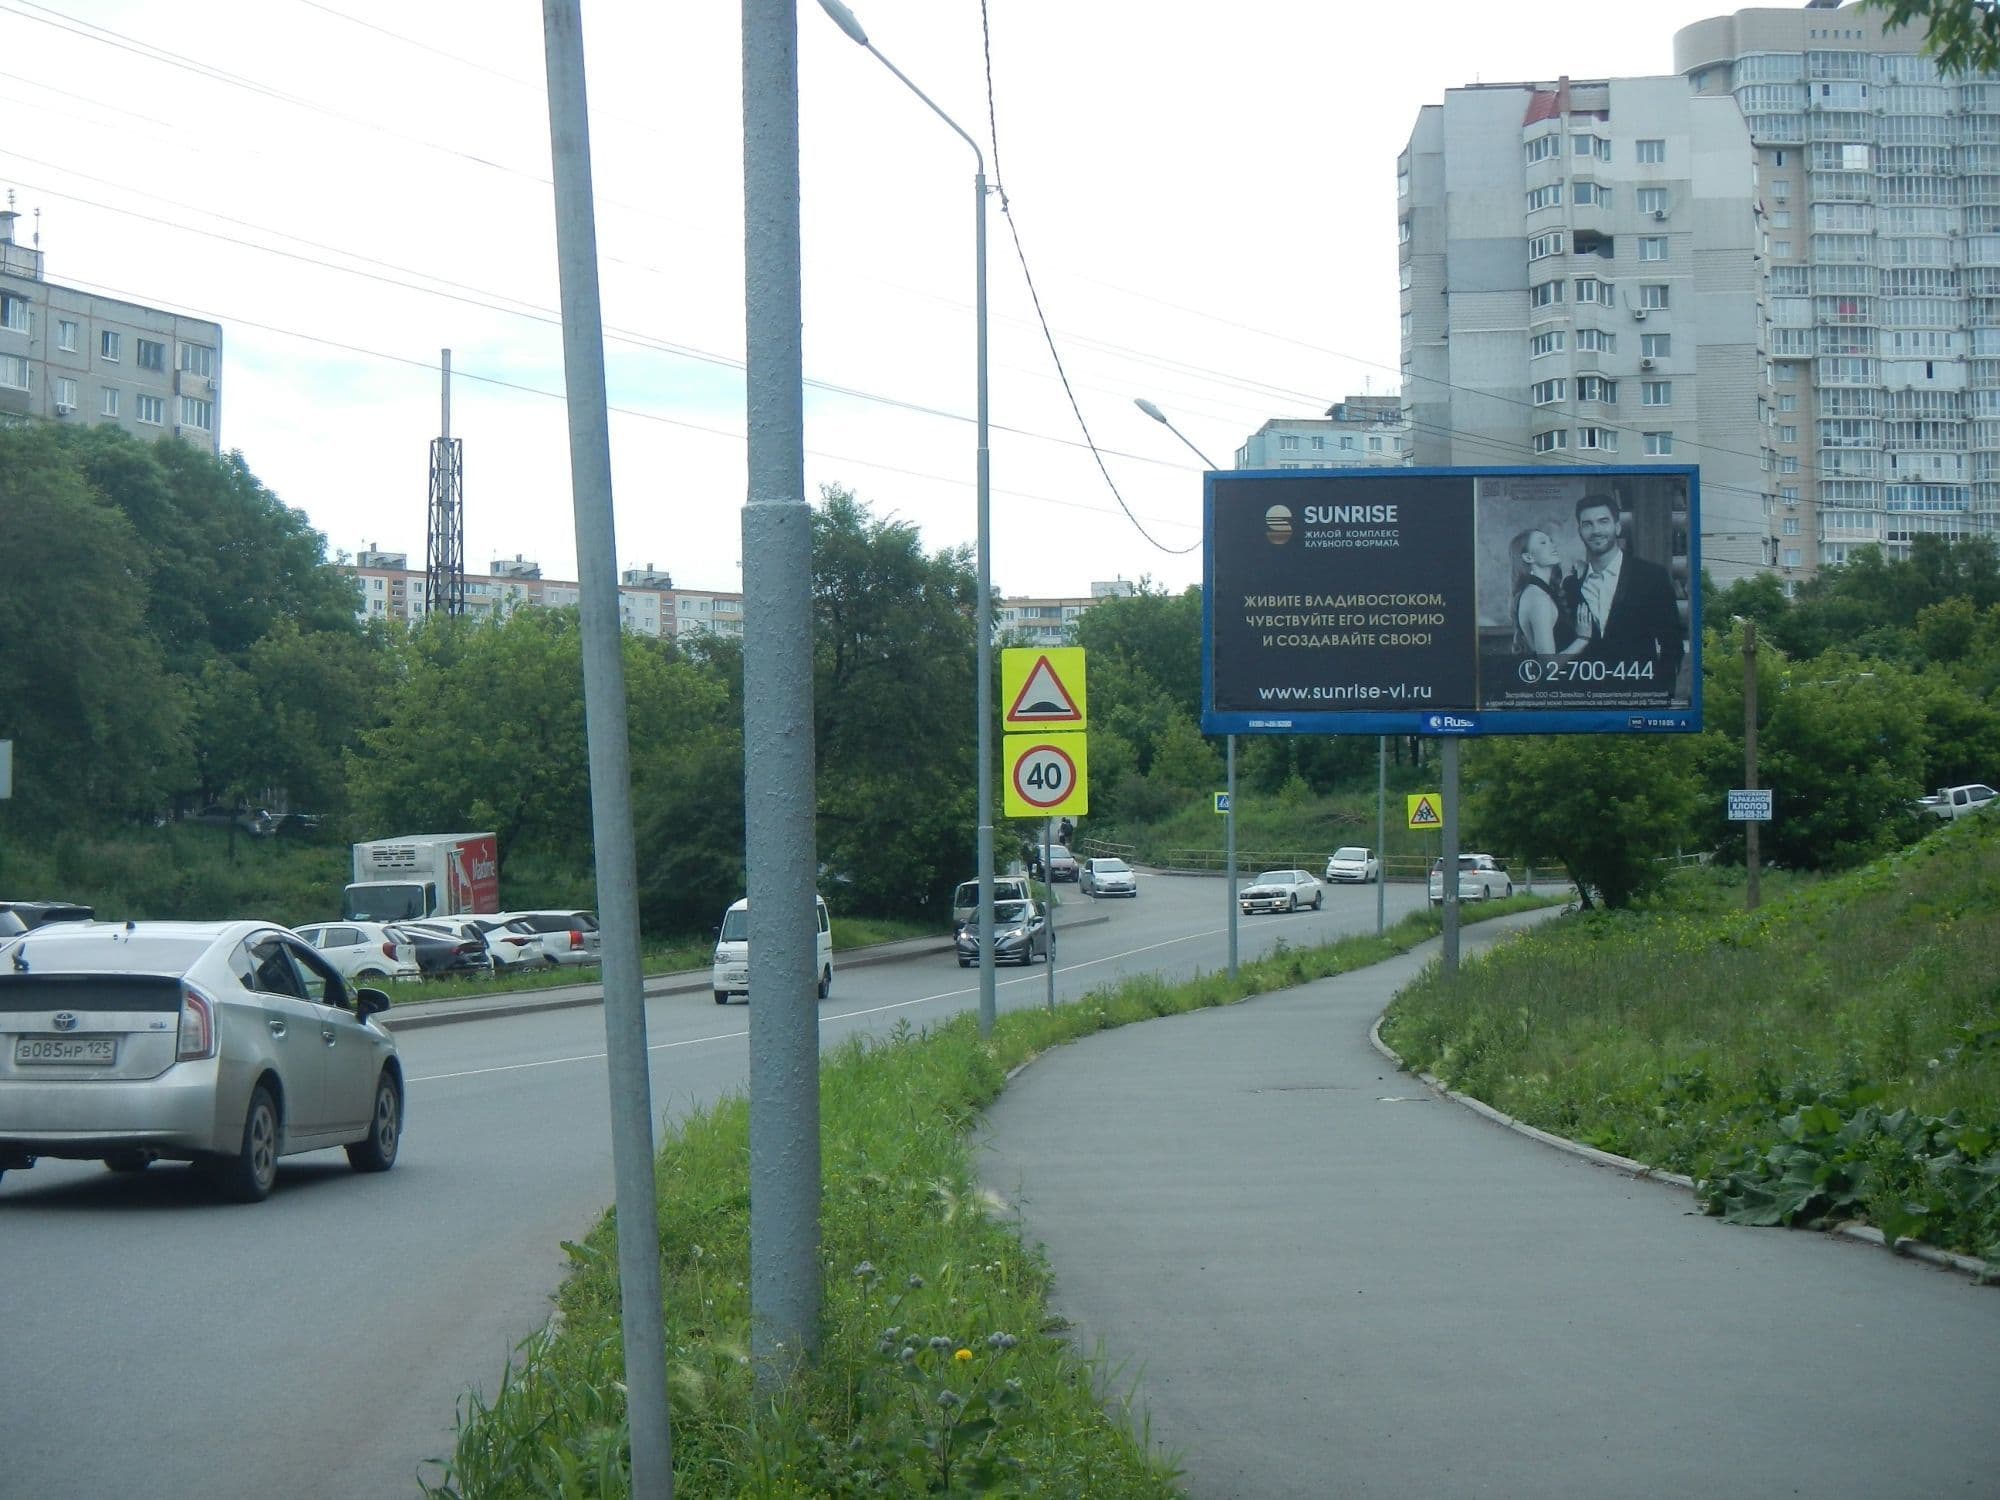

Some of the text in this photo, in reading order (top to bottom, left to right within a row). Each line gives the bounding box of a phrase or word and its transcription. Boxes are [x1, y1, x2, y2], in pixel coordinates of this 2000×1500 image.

[1304, 505, 1398, 524] SUNRISE
[1304, 529, 1400, 538] ЖИЛОЙ КОМПЛЕКС
[1304, 539, 1400, 548] КЛУБНОГО ФОРМАТА
[1244, 593, 1447, 608] ЖИВИТЕ ВЛАДИВОСТОКОМ,
[1246, 613, 1445, 627] ЧУВСТВУЙТЕ ЕГО ИСТОРИЮ
[1262, 632, 1432, 647] И СОЗДАВАЙТЕ СВОЮ!
[1545, 660, 1655, 681] 2-700-444
[1258, 683, 1433, 699] www.sunrise-vl.ru
[1027, 762, 1062, 790] 40
[1732, 802, 1768, 810] КЛОПОВ
[87, 1042, 112, 1054] 125
